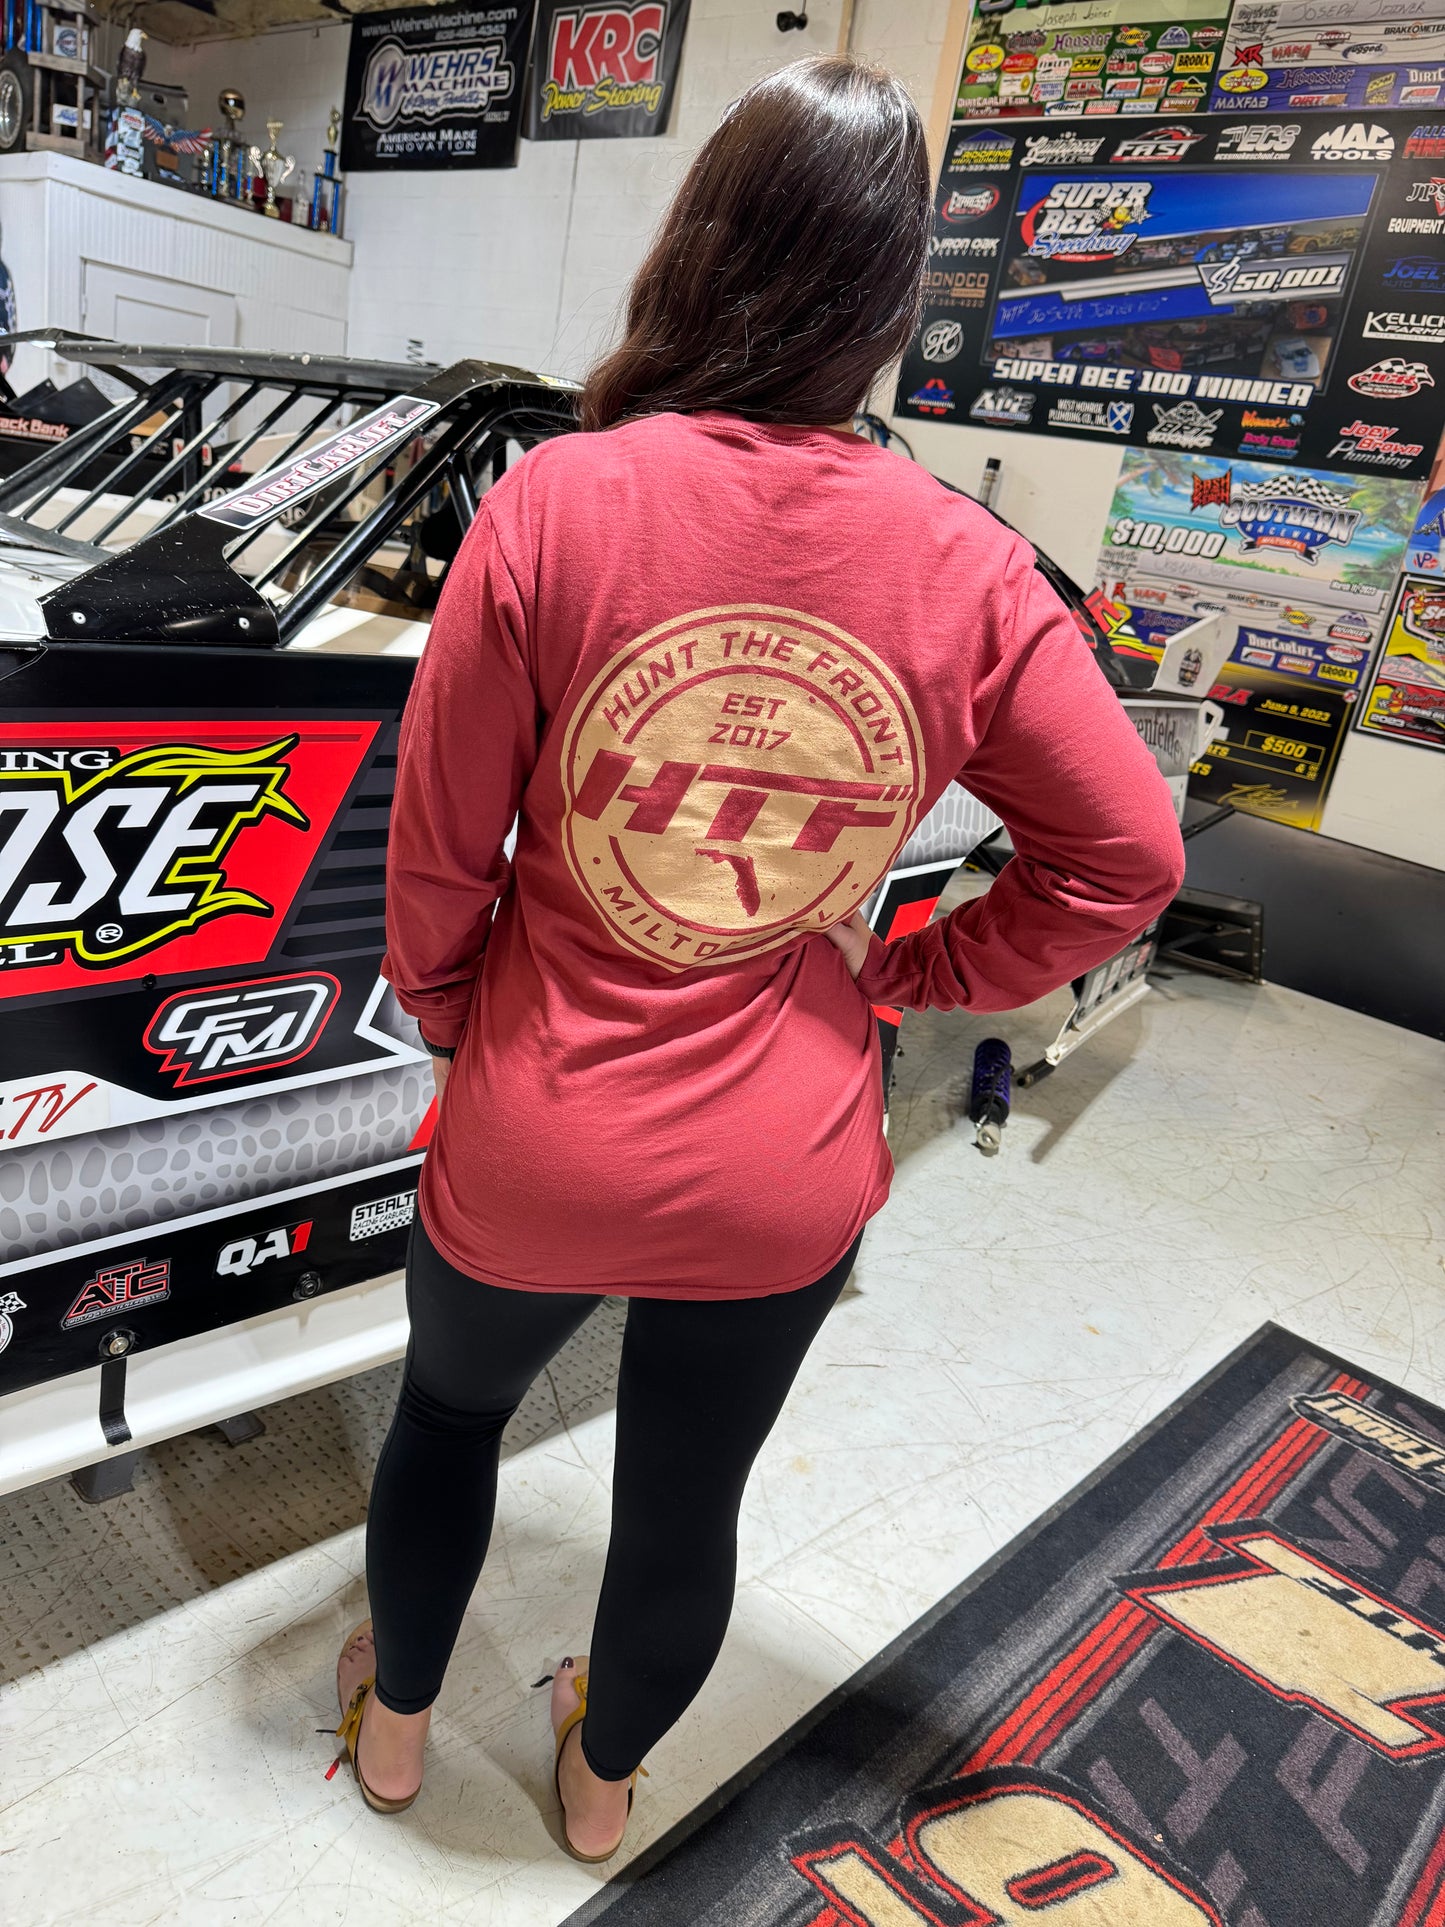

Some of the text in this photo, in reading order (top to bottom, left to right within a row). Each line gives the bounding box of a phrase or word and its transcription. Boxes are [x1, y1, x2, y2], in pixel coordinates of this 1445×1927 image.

[362, 7, 518, 38] www.WehrsMachine.com
[551, 5, 664, 90] KRC
[1179, 53, 1210, 67] BRODIX
[1231, 43, 1263, 67] XR
[407, 48, 500, 82] WEHRS
[400, 73, 507, 93] MACHINE
[543, 78, 663, 118] Power Steering
[1214, 95, 1269, 110] MAXFAB
[376, 137, 478, 153] INNOVATION
[380, 128, 479, 143] AMERICAN MADE
[1113, 140, 1197, 157] FAST
[1236, 124, 1301, 152] ECS
[1312, 123, 1395, 150] MAC
[1310, 150, 1393, 161] TOOLS
[1043, 181, 1153, 209] SUPER
[1034, 208, 1100, 235] BEE
[1388, 217, 1443, 235] EQUIPMENT
[1027, 227, 1138, 260] Speedway
[1208, 255, 1343, 297] $50,001
[990, 357, 1315, 409] SUPER BEE 100 WINNER
[1057, 399, 1075, 411] WEST
[29, 418, 70, 438] Bank
[1338, 419, 1400, 441] Joey
[1326, 438, 1413, 470] Plumbing
[1355, 436, 1425, 458] Brown
[1222, 497, 1361, 543] SOUTHERN
[1244, 523, 1324, 543] RACEWAY
[1110, 516, 1226, 560] $10,000
[1415, 552, 1433, 568] VP
[601, 630, 906, 768] HUNT THE FRONT
[720, 693, 788, 720] EST
[1260, 699, 1288, 713] June
[707, 722, 793, 751] 2017
[1261, 736, 1308, 760] $500
[572, 747, 914, 854] HTF
[602, 884, 742, 959] MILTO
[7, 1081, 99, 1140] TV
[355, 1191, 418, 1222] STEALT
[352, 1216, 379, 1231] RACING
[215, 1220, 315, 1276] QA1
[66, 1262, 168, 1319] ATC
